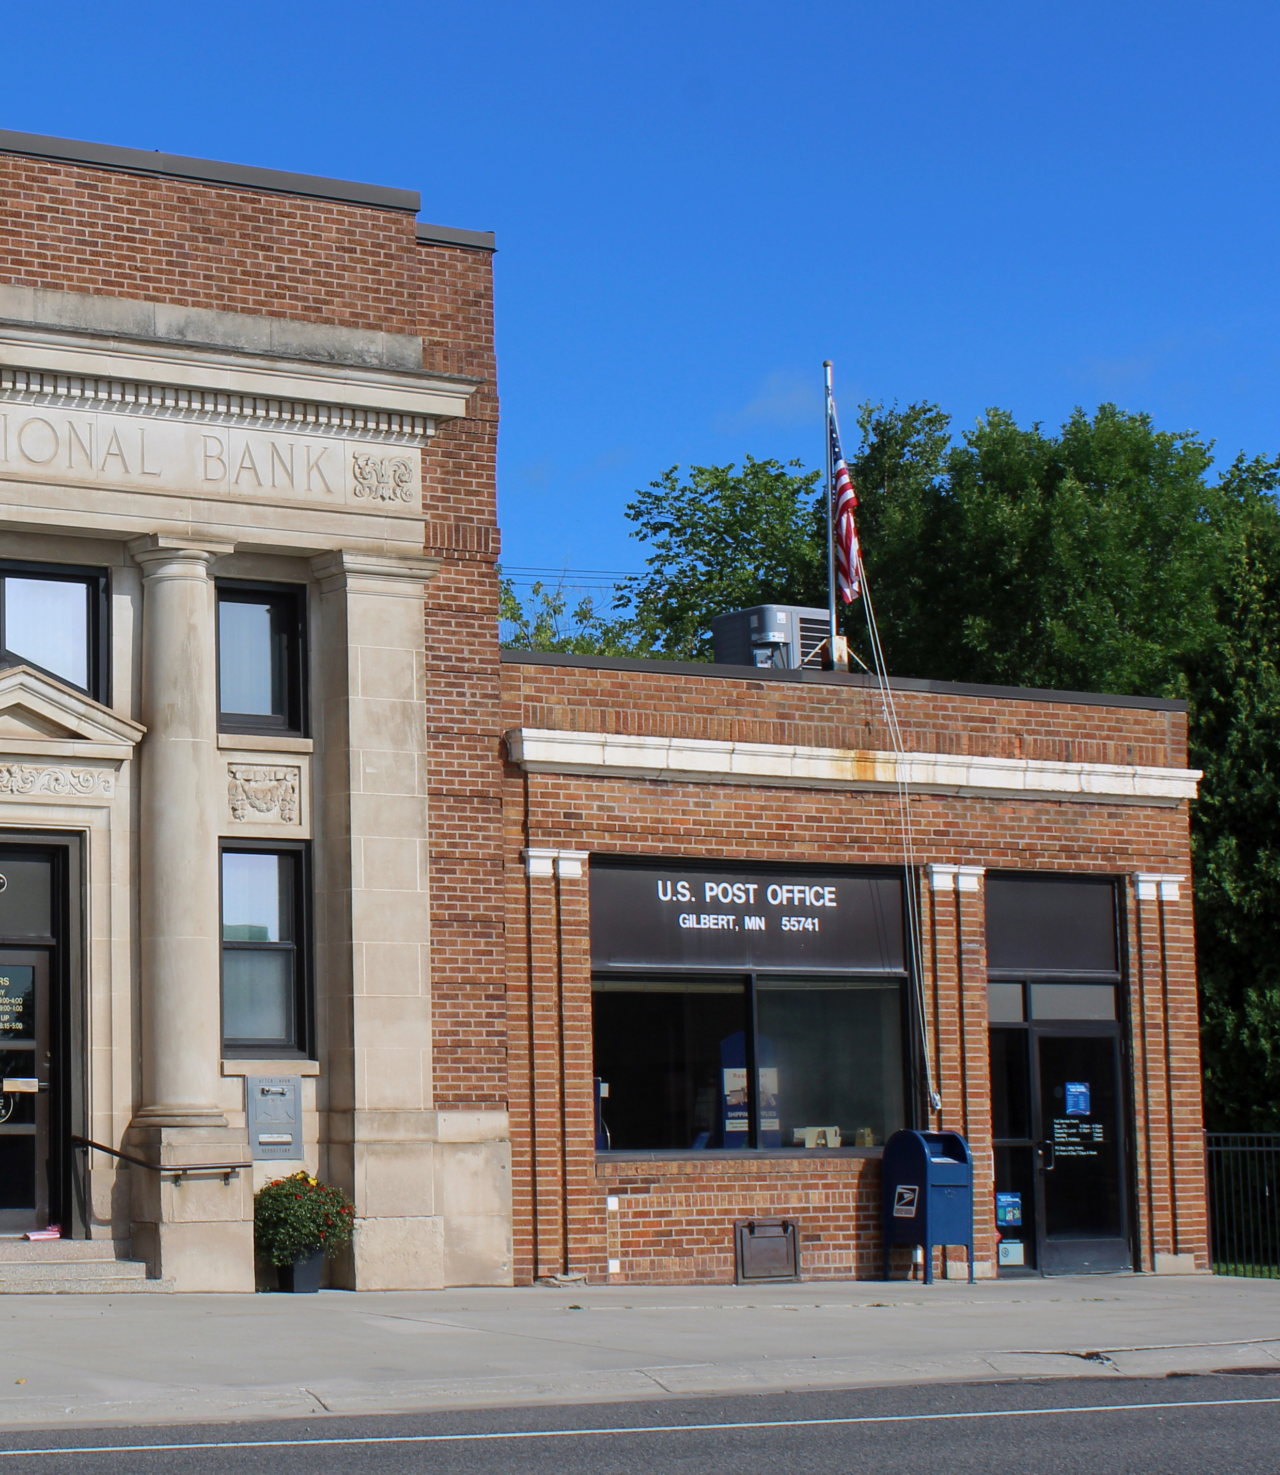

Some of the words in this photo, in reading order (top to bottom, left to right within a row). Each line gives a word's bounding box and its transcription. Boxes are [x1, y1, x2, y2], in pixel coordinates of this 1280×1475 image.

[201, 434, 333, 494] BANK
[657, 880, 696, 901] U.S.
[705, 882, 758, 904] POST
[767, 885, 837, 907] OFFICE
[679, 914, 739, 931] GILBERT,
[744, 916, 766, 930] MN
[781, 917, 819, 931] 55741
